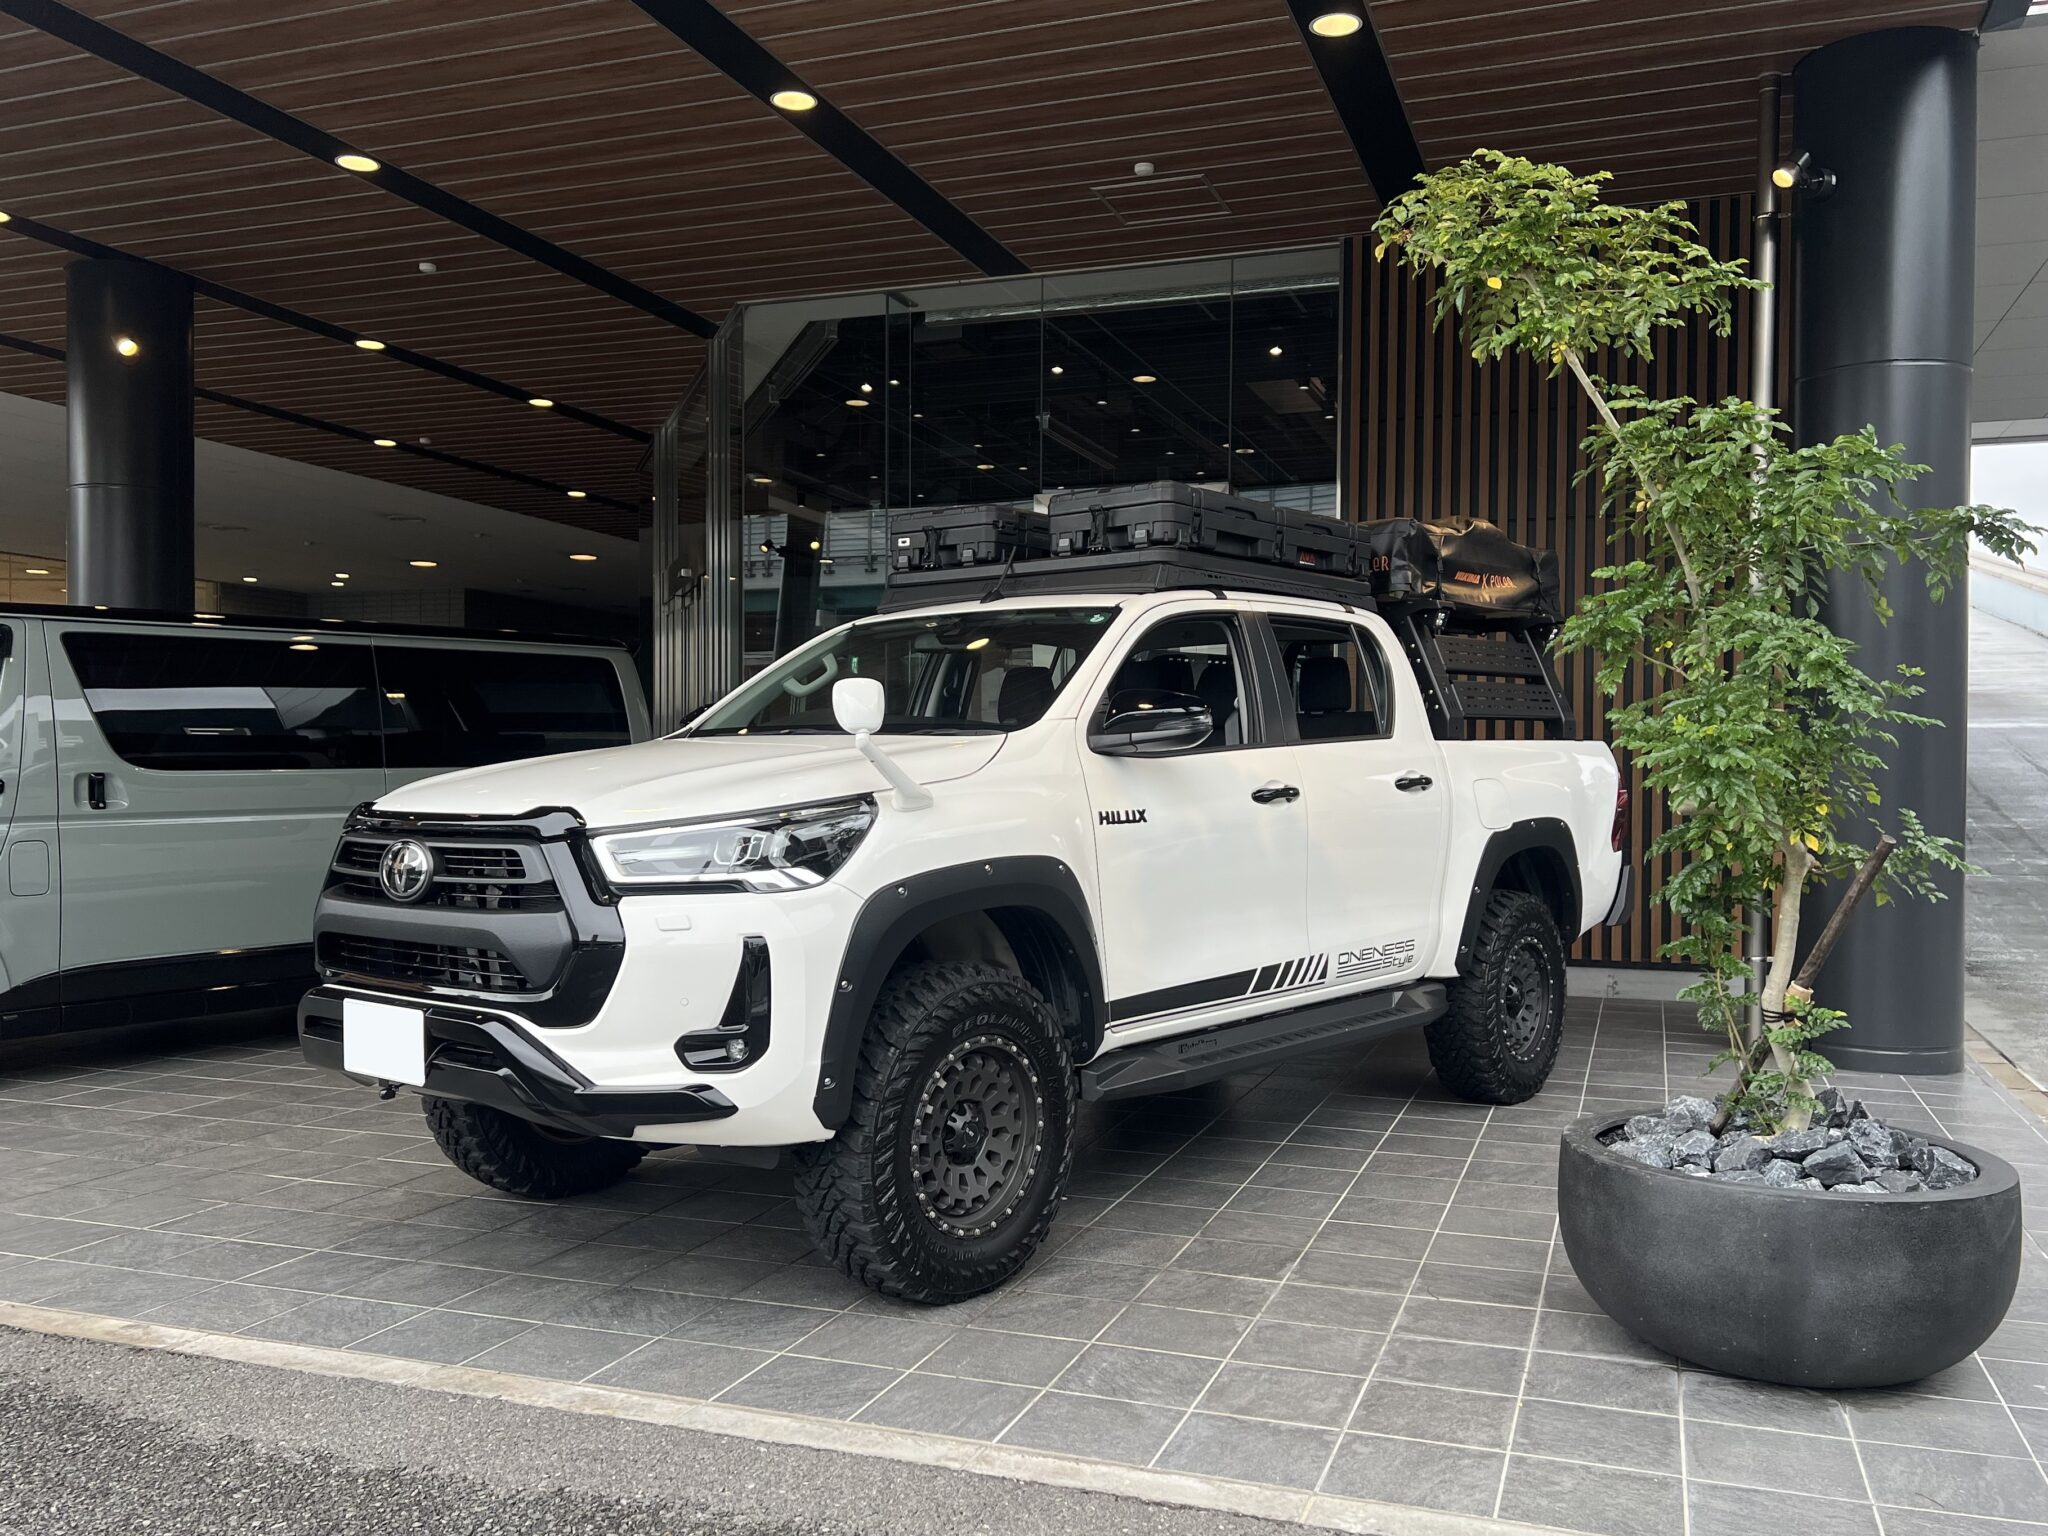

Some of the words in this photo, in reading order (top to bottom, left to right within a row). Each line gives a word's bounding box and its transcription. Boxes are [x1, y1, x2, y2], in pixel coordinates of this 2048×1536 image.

[1098, 808, 1148, 825] HILUX
[1338, 939, 1415, 965] ONENESS
[1382, 953, 1414, 969] Style
